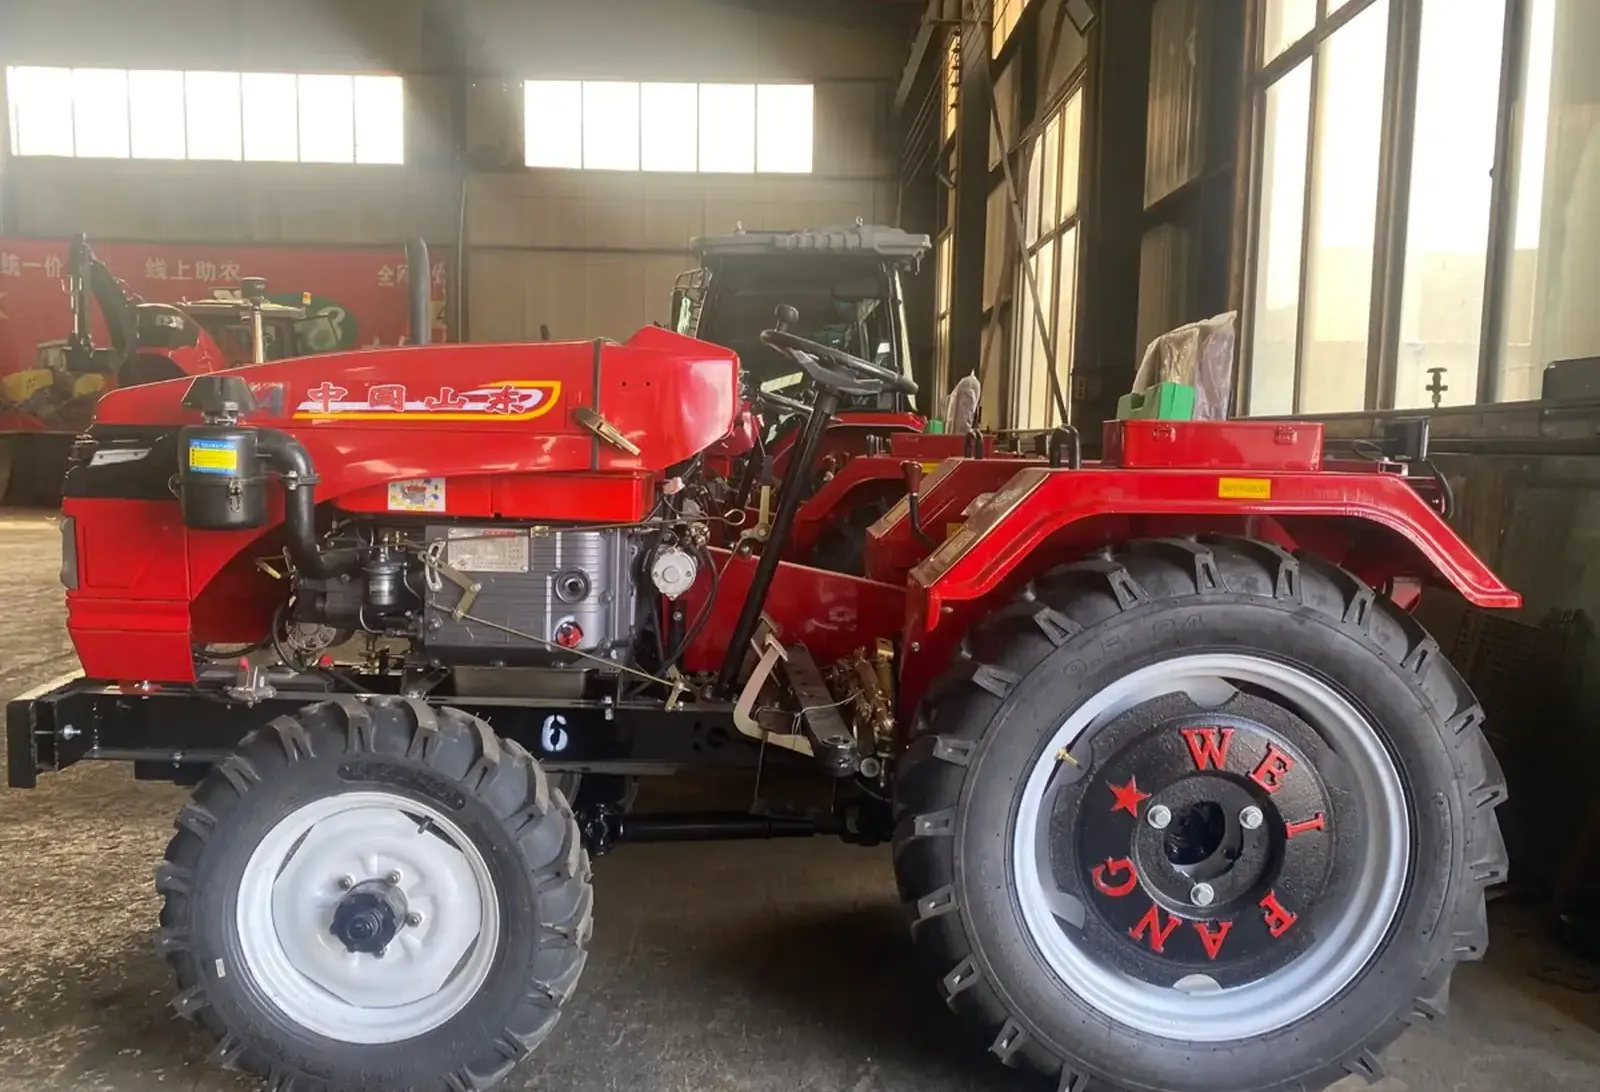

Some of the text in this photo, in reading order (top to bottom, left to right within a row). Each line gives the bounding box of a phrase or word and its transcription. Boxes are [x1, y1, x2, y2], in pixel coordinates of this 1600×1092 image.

[145, 257, 243, 282] 线上助农
[308, 382, 532, 415] 中国山东
[541, 714, 569, 752] 6
